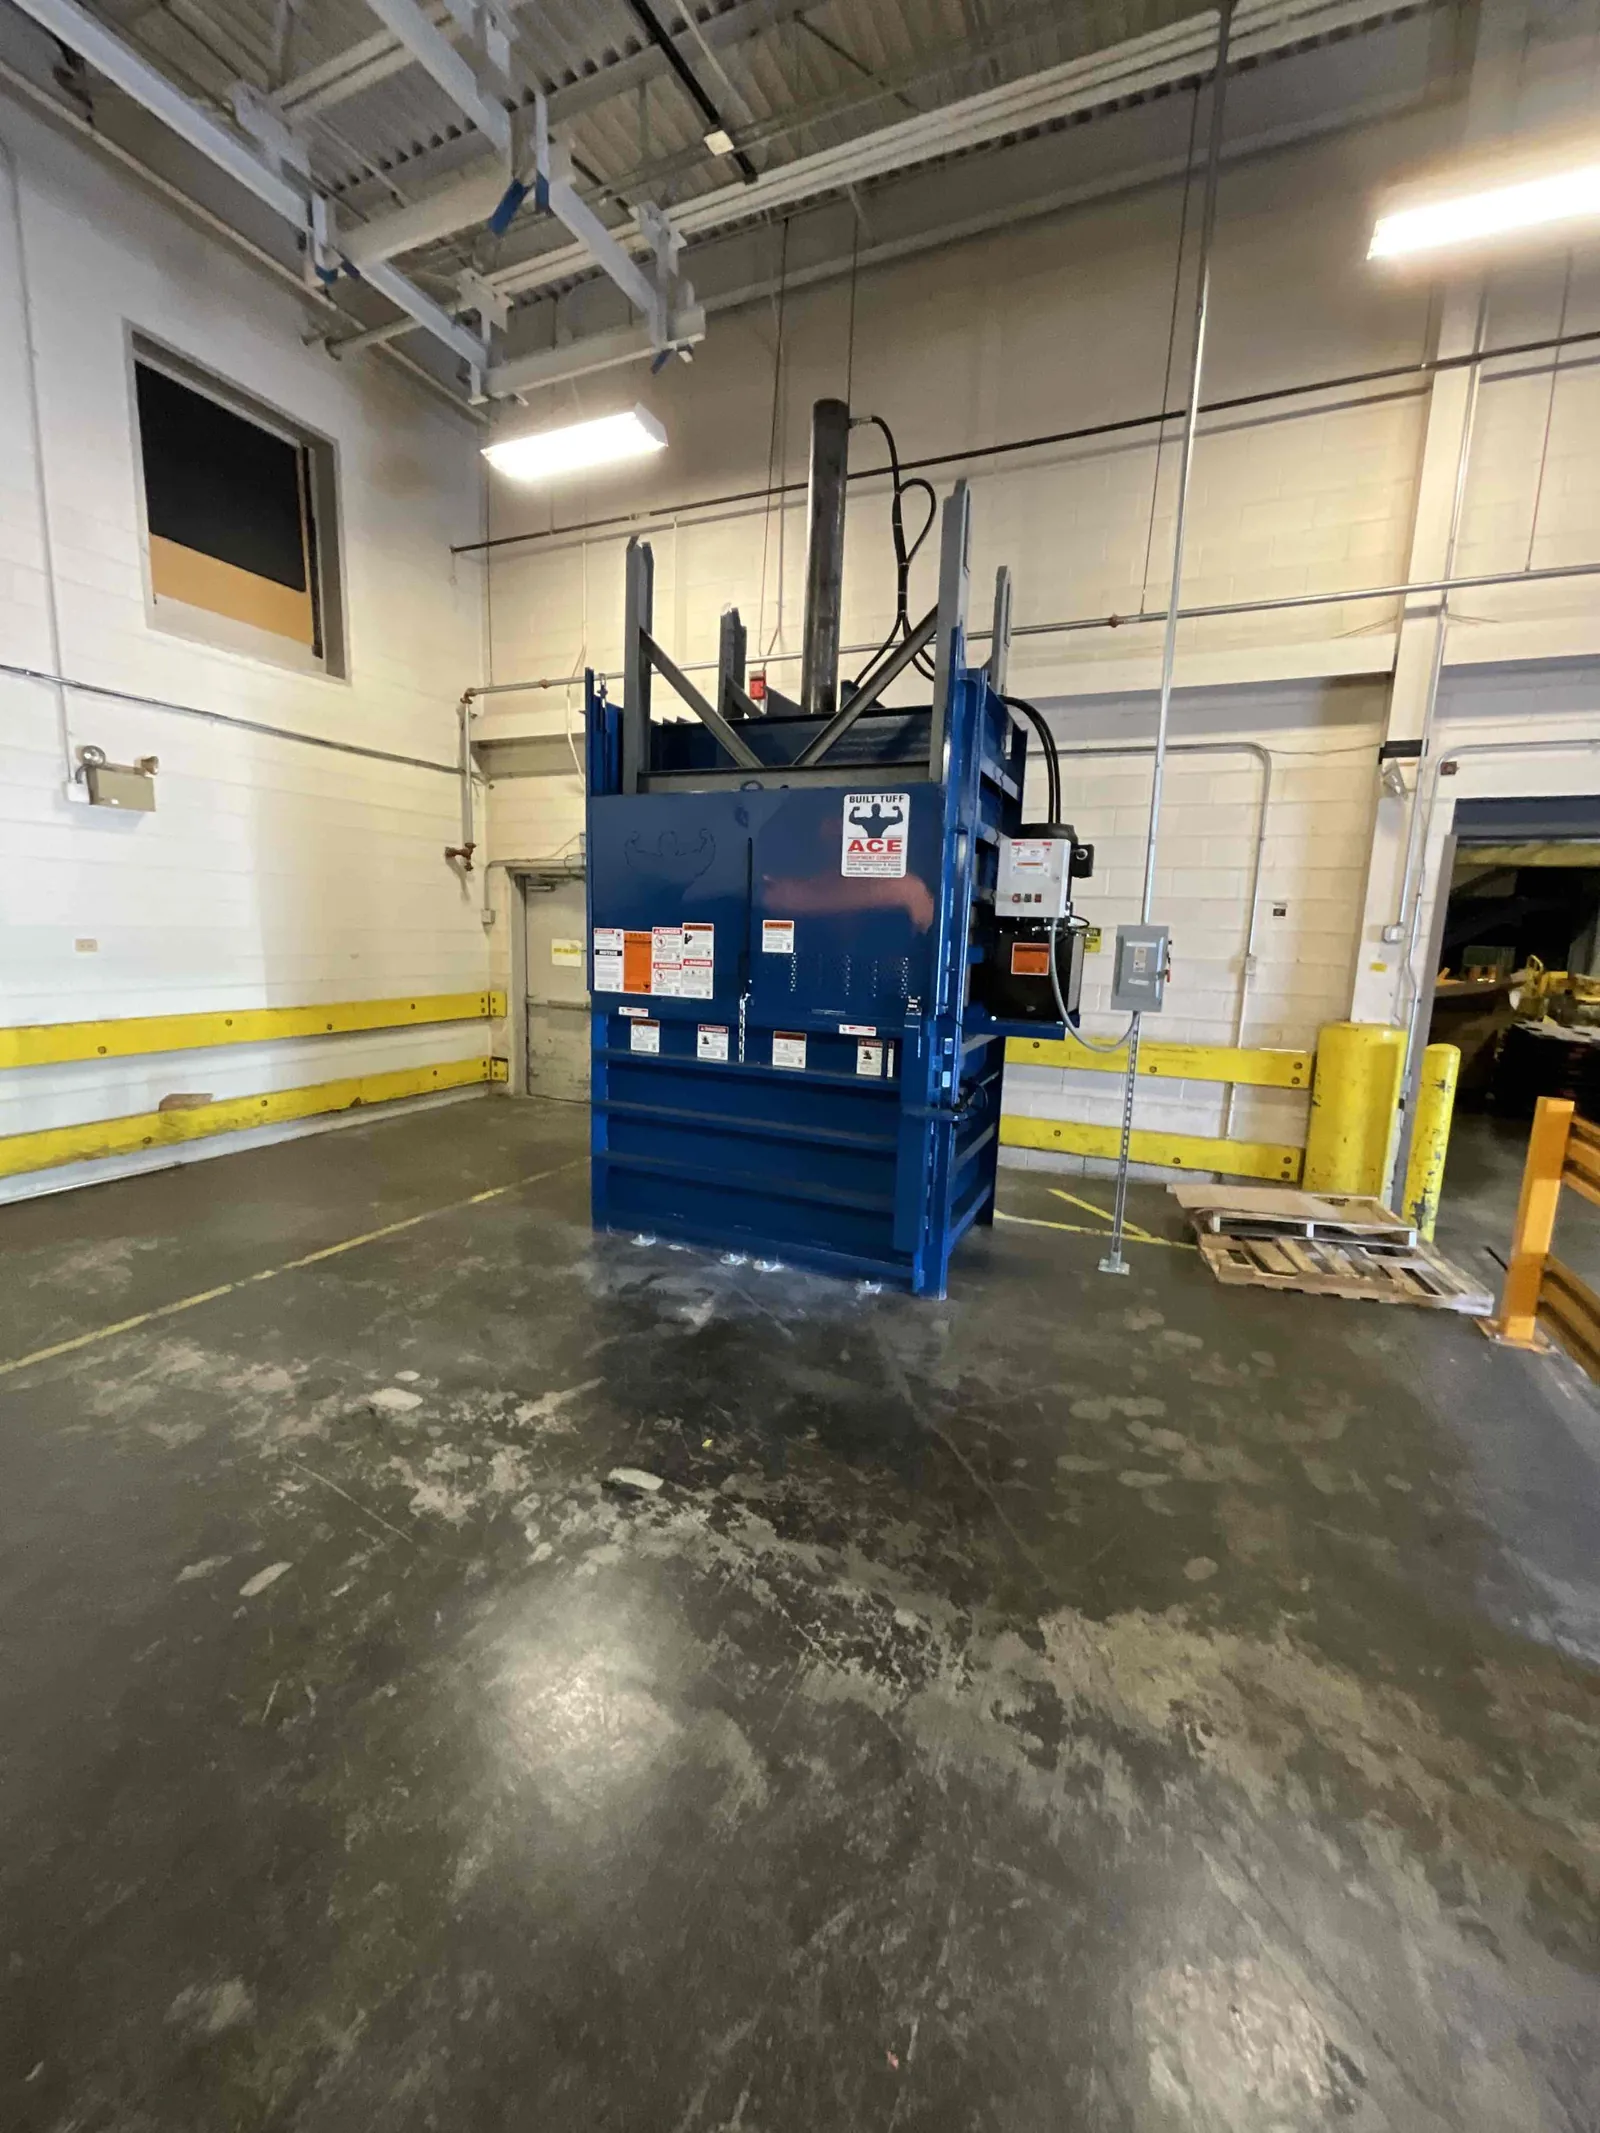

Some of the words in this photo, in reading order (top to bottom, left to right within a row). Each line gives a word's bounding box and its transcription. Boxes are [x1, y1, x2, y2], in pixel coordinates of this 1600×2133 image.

[849, 795, 876, 803] BUILT
[880, 795, 904, 803] TUFF
[847, 839, 902, 853] ACE
